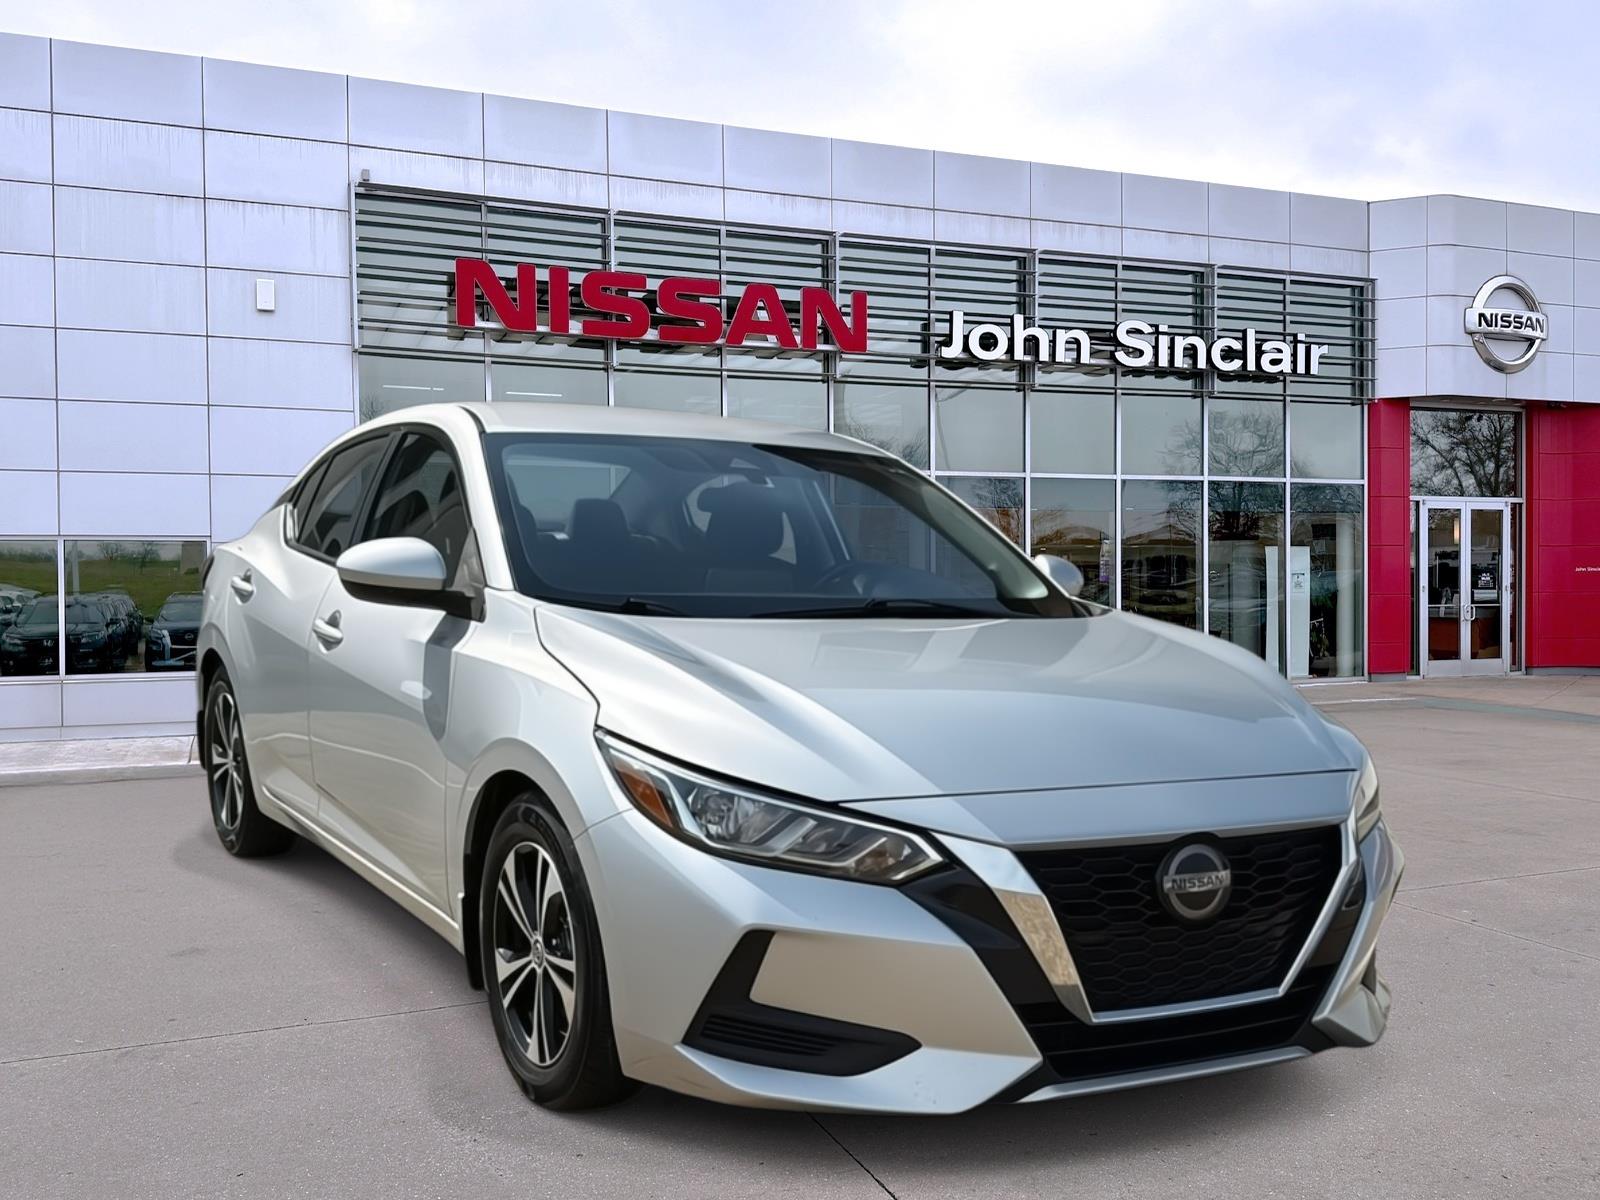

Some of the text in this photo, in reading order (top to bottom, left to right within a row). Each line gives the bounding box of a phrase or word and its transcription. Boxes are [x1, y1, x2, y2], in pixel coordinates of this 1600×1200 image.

[455, 257, 868, 354] NISSAN
[1478, 312, 1545, 333] NISSAN
[940, 309, 1328, 375] John Sinclair
[1171, 875, 1225, 889] NISSAN
